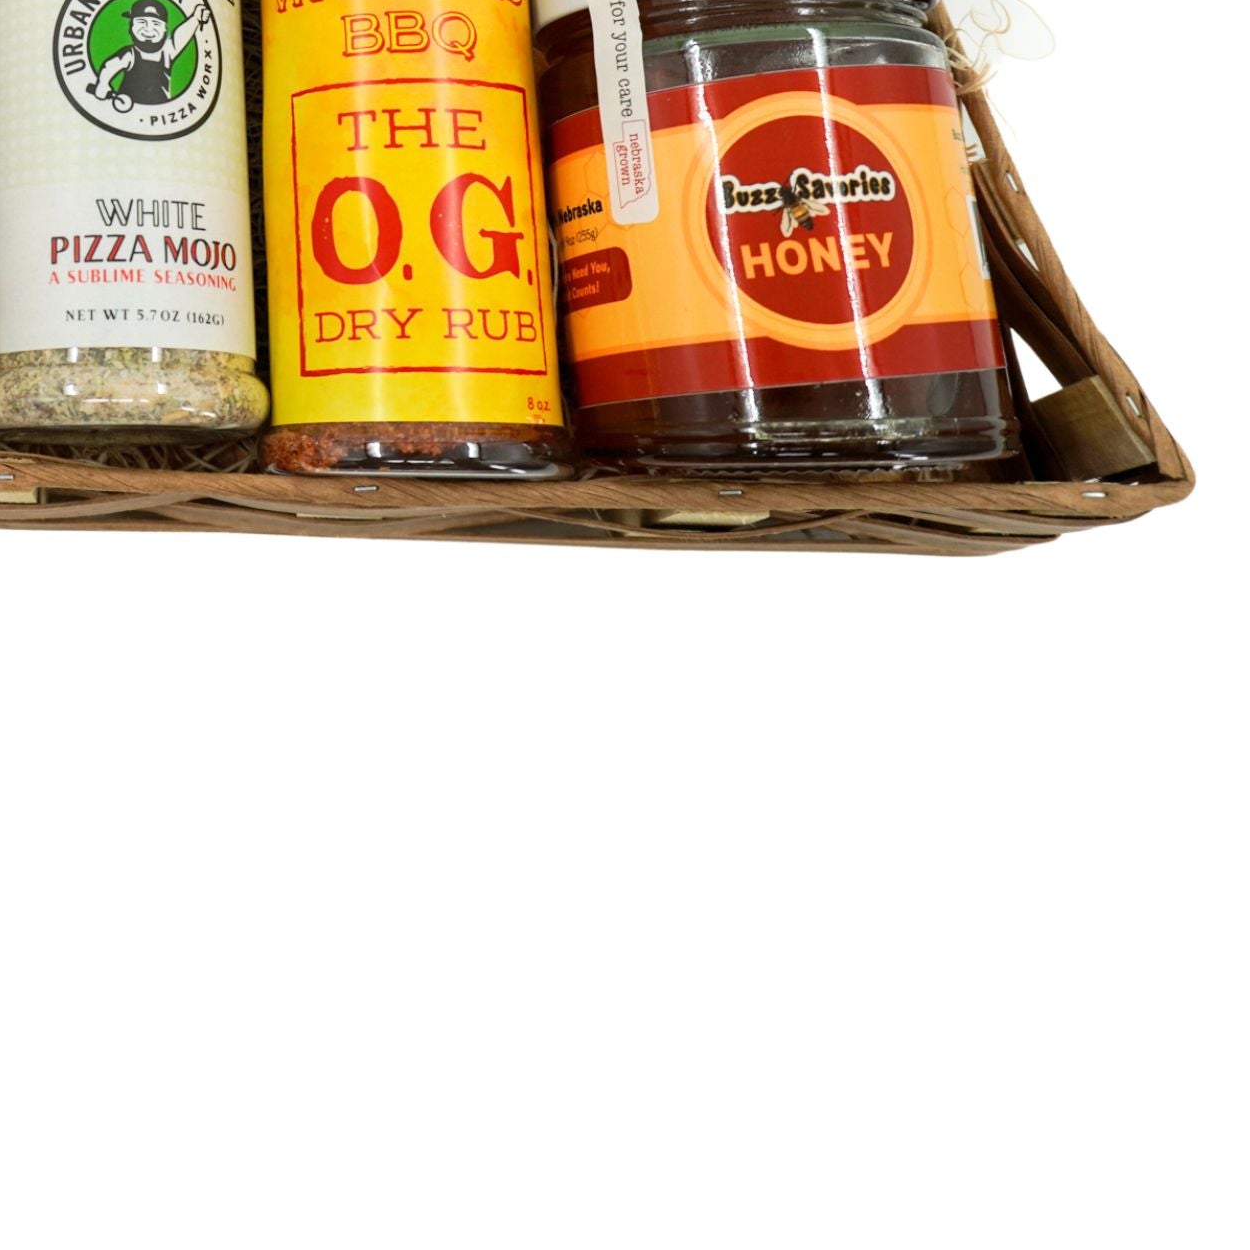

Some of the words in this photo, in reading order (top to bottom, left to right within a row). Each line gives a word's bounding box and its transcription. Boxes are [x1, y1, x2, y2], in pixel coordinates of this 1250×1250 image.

[609, 0, 627, 26] for
[341, 10, 477, 62] BBQ
[610, 31, 629, 76] your
[149, 102, 198, 127] PIZZA
[196, 48, 214, 101] WORX
[618, 78, 634, 119] care
[337, 108, 486, 151] THE
[615, 144, 631, 187] grown
[629, 133, 646, 195] nebraska
[95, 198, 207, 231] WHITE
[311, 172, 534, 286] O.G.
[558, 198, 603, 224] Nebraska
[50, 234, 153, 265] PIZZA
[164, 235, 237, 271] MOJO
[576, 227, 599, 243] (255g)
[590, 261, 611, 276] You,
[740, 232, 894, 280] HONEY
[49, 270, 60, 285] A
[67, 268, 145, 285] SUBLIME
[154, 270, 237, 292] SEASONING
[571, 280, 600, 300] Counts!
[66, 309, 97, 322] NET
[103, 308, 129, 321] WT
[186, 311, 225, 327] (162G)
[315, 308, 423, 343] DRY
[442, 309, 538, 343] RUB
[527, 396, 534, 411] 8
